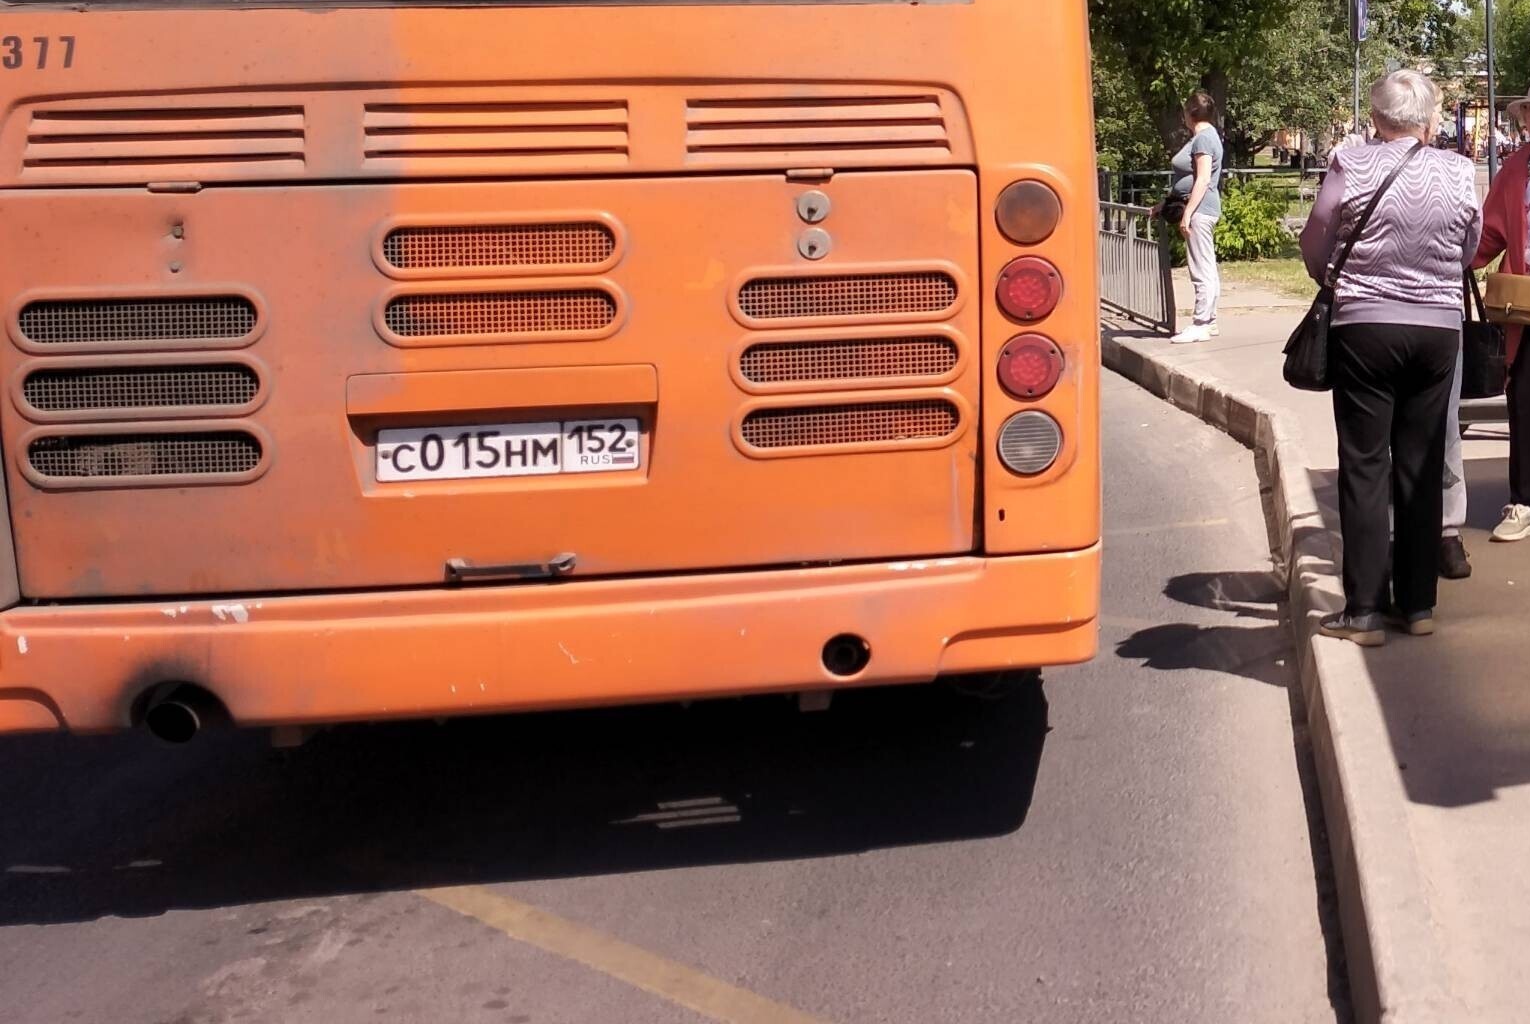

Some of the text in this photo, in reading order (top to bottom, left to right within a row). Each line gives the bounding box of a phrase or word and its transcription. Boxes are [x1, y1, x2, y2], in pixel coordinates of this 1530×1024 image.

[2, 35, 76, 70] 377
[567, 424, 628, 454] 152
[580, 453, 611, 465] RUS
